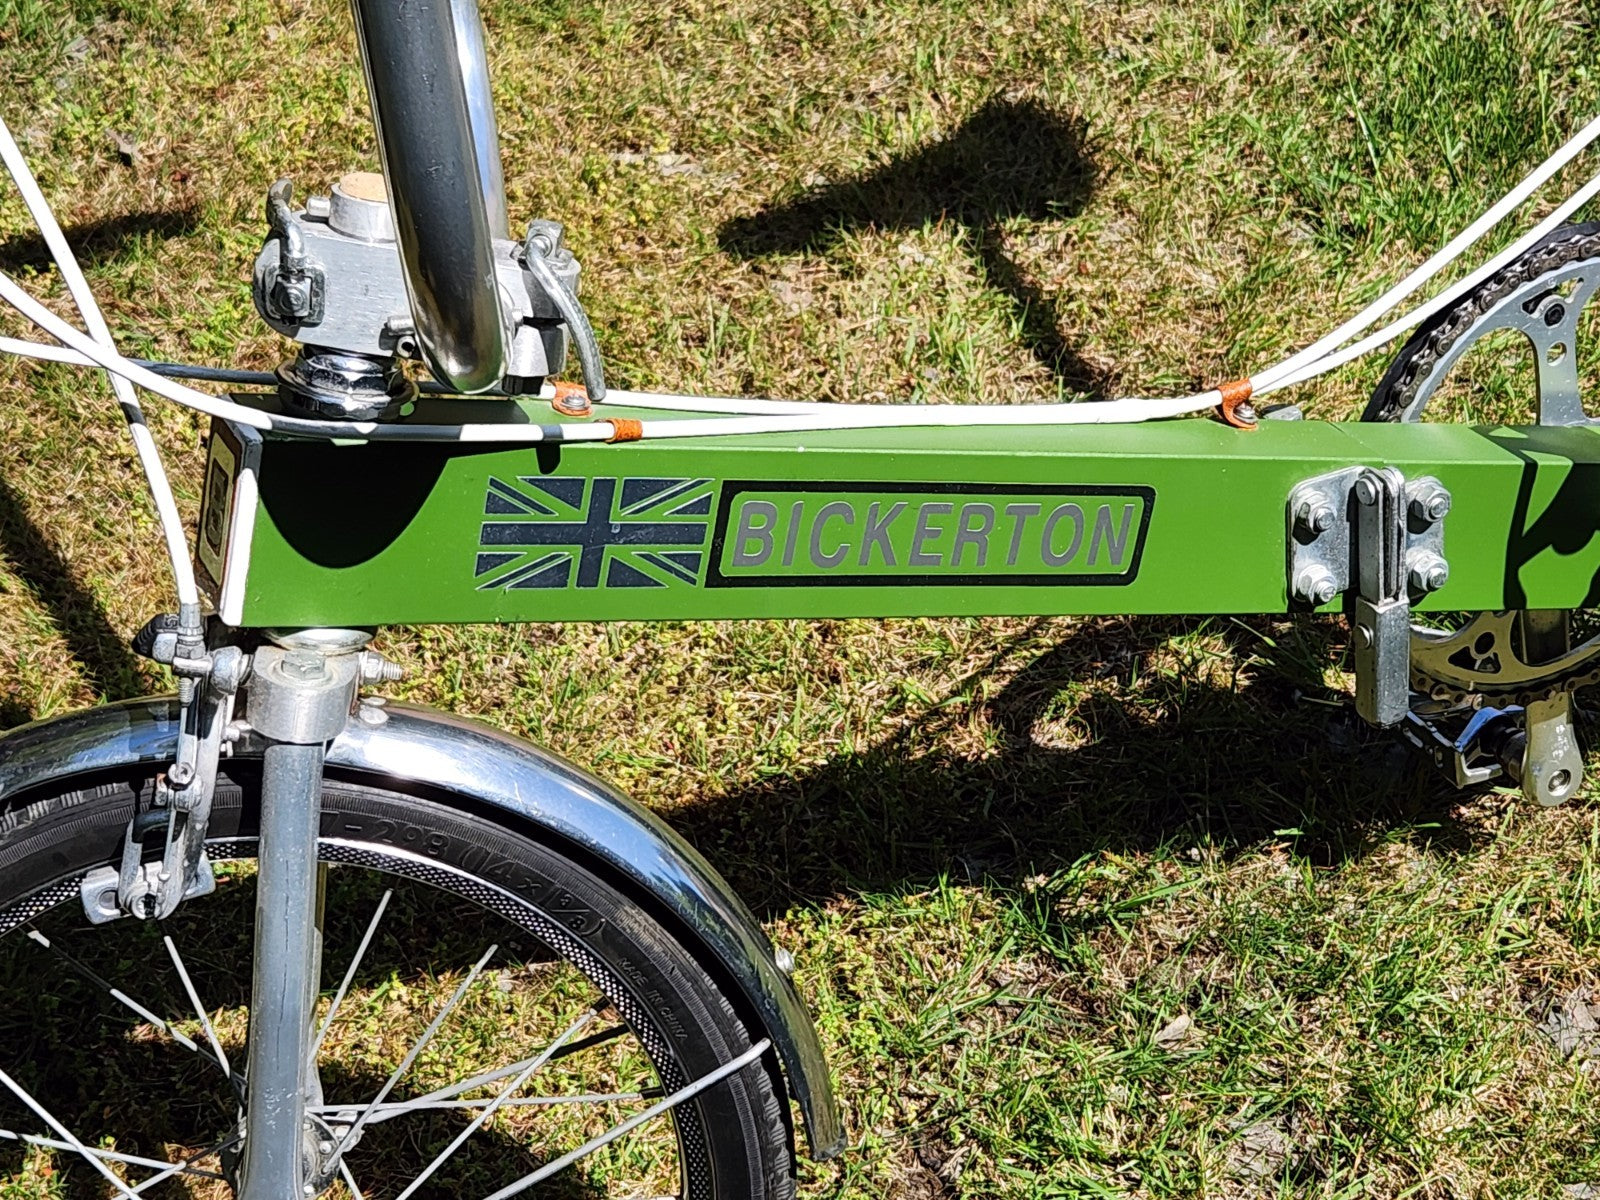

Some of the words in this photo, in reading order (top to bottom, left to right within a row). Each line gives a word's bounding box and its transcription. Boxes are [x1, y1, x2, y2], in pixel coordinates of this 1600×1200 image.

[731, 501, 1136, 568] BICKERTON
[616, 957, 649, 988] MADE
[645, 989, 664, 1007] IN
[660, 1006, 688, 1041] CHINA
